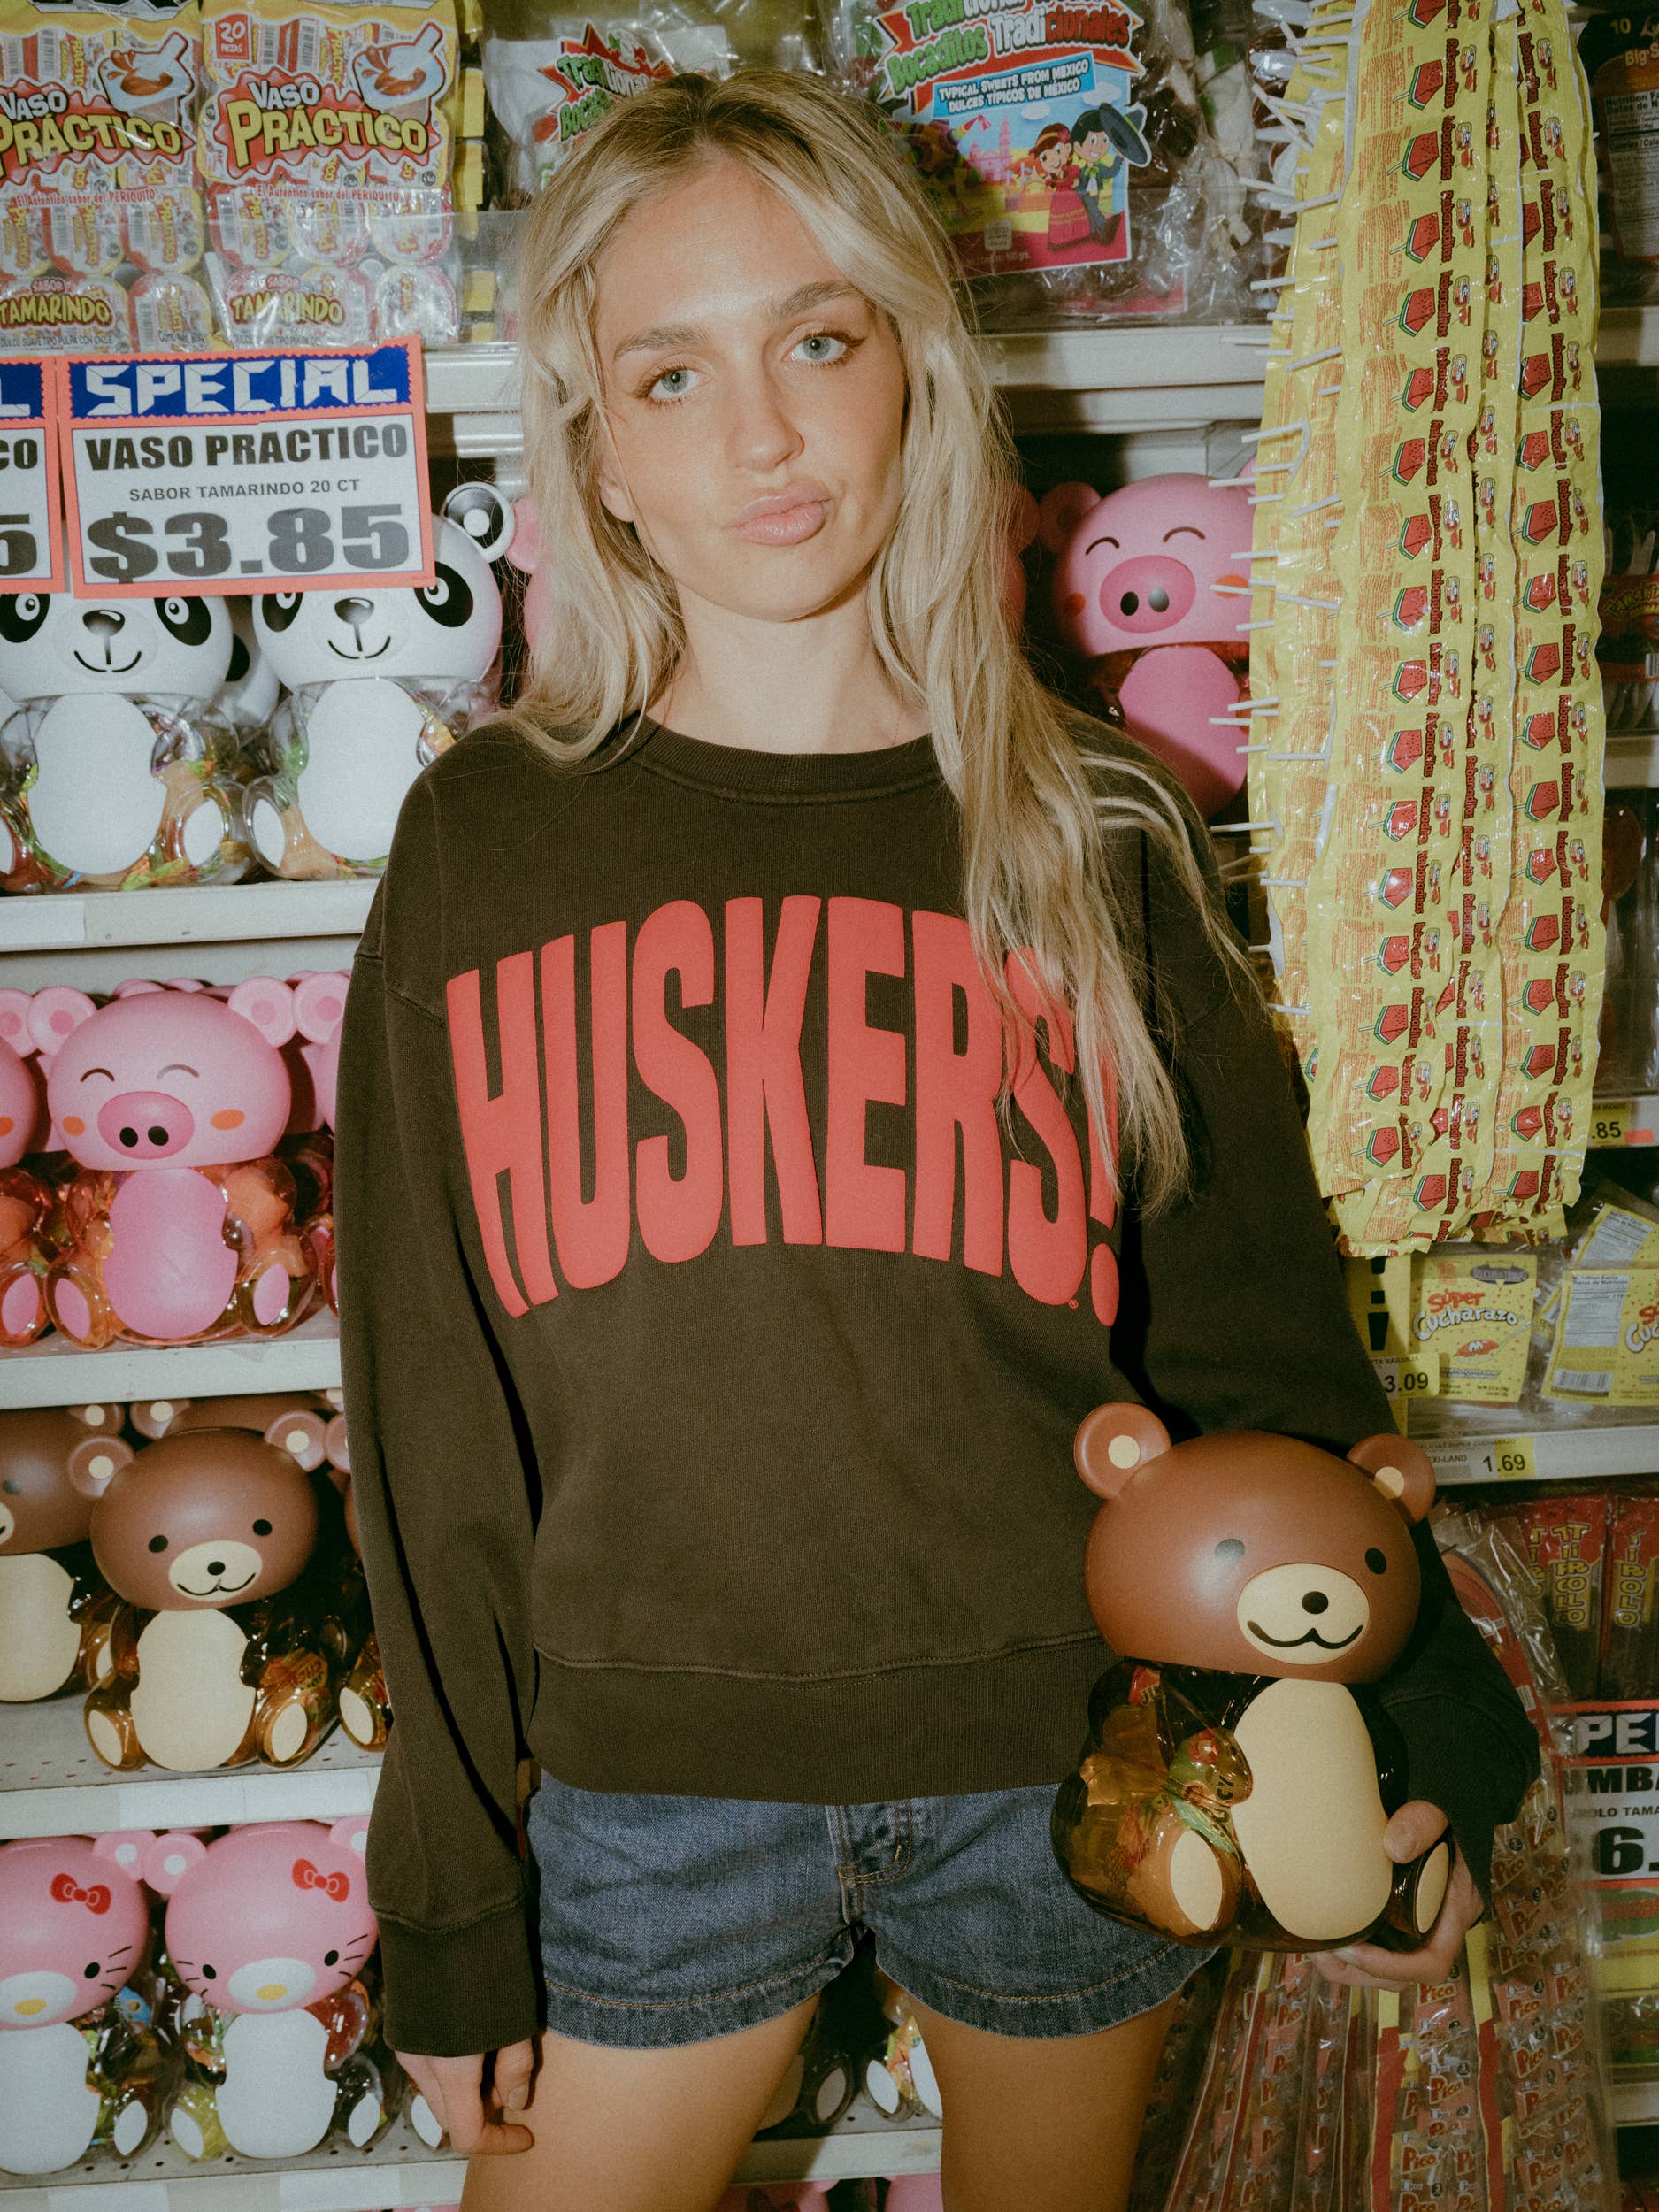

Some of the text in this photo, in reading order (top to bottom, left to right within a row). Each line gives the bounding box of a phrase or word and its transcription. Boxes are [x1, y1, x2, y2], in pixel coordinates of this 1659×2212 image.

[219, 22, 246, 43] 20
[1609, 17, 1632, 35] 10
[886, 5, 1131, 92] Bocaditos Tradicionales
[939, 58, 1090, 100] TYPICAL SWEETS FROM MEXICO
[0, 89, 68, 121] VASO
[247, 79, 321, 111] VASO
[948, 78, 1081, 114] DULCES TÍPICOS DE MÉXICO
[226, 99, 429, 169] PRÁCTICO
[94, 192, 106, 203] del
[110, 189, 156, 204] PERIQUITO
[257, 185, 266, 197] El
[335, 187, 350, 199] del
[351, 188, 399, 202] PERIQUITO
[32, 280, 65, 293] SABOR
[265, 274, 302, 290] SABOR
[0, 294, 111, 327] TAMARINDO
[231, 290, 345, 326] TAMARINDO
[85, 358, 398, 416] SPECIAL
[85, 435, 194, 471] VASO
[206, 423, 408, 467] PRACTICO
[129, 479, 360, 502] SABOR TAMARINDO 20 CT
[88, 503, 411, 584] $3.85
[1413, 1306, 1518, 1341] Cucharazo
[1384, 1372, 1429, 1394] 3.09
[1483, 1455, 1525, 1473] 1.69
[1567, 1521, 1591, 1624] TIROLO
[1508, 1997, 1541, 2024] Pico
[1513, 2047, 1546, 2078] Pico
[1429, 2076, 1464, 2103] Pico
[1402, 2146, 1438, 2174] Pico
